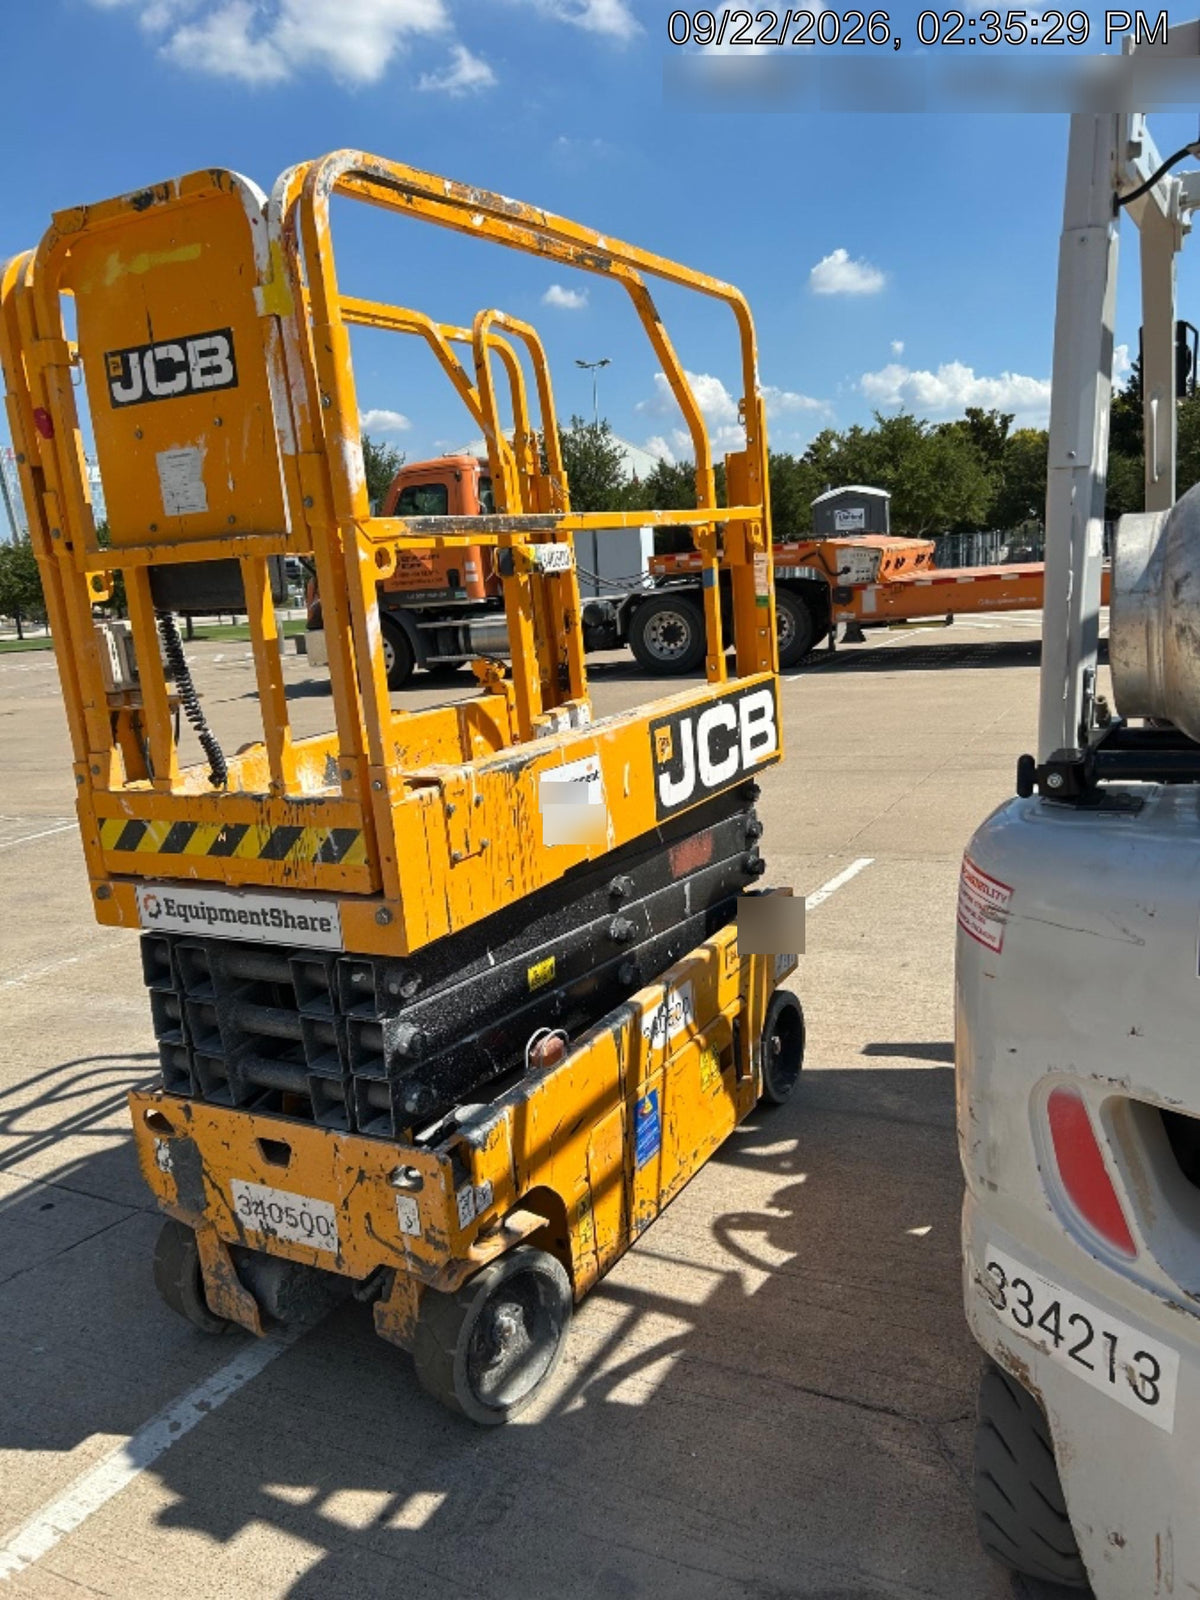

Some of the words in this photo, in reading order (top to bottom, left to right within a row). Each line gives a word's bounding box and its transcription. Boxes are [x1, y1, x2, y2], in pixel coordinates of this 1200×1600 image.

[111, 336, 233, 402] JCB
[658, 689, 777, 807] JCB
[163, 898, 332, 932] EquipmentShare
[238, 1195, 331, 1237] 340500
[987, 1262, 1161, 1406] 334213
